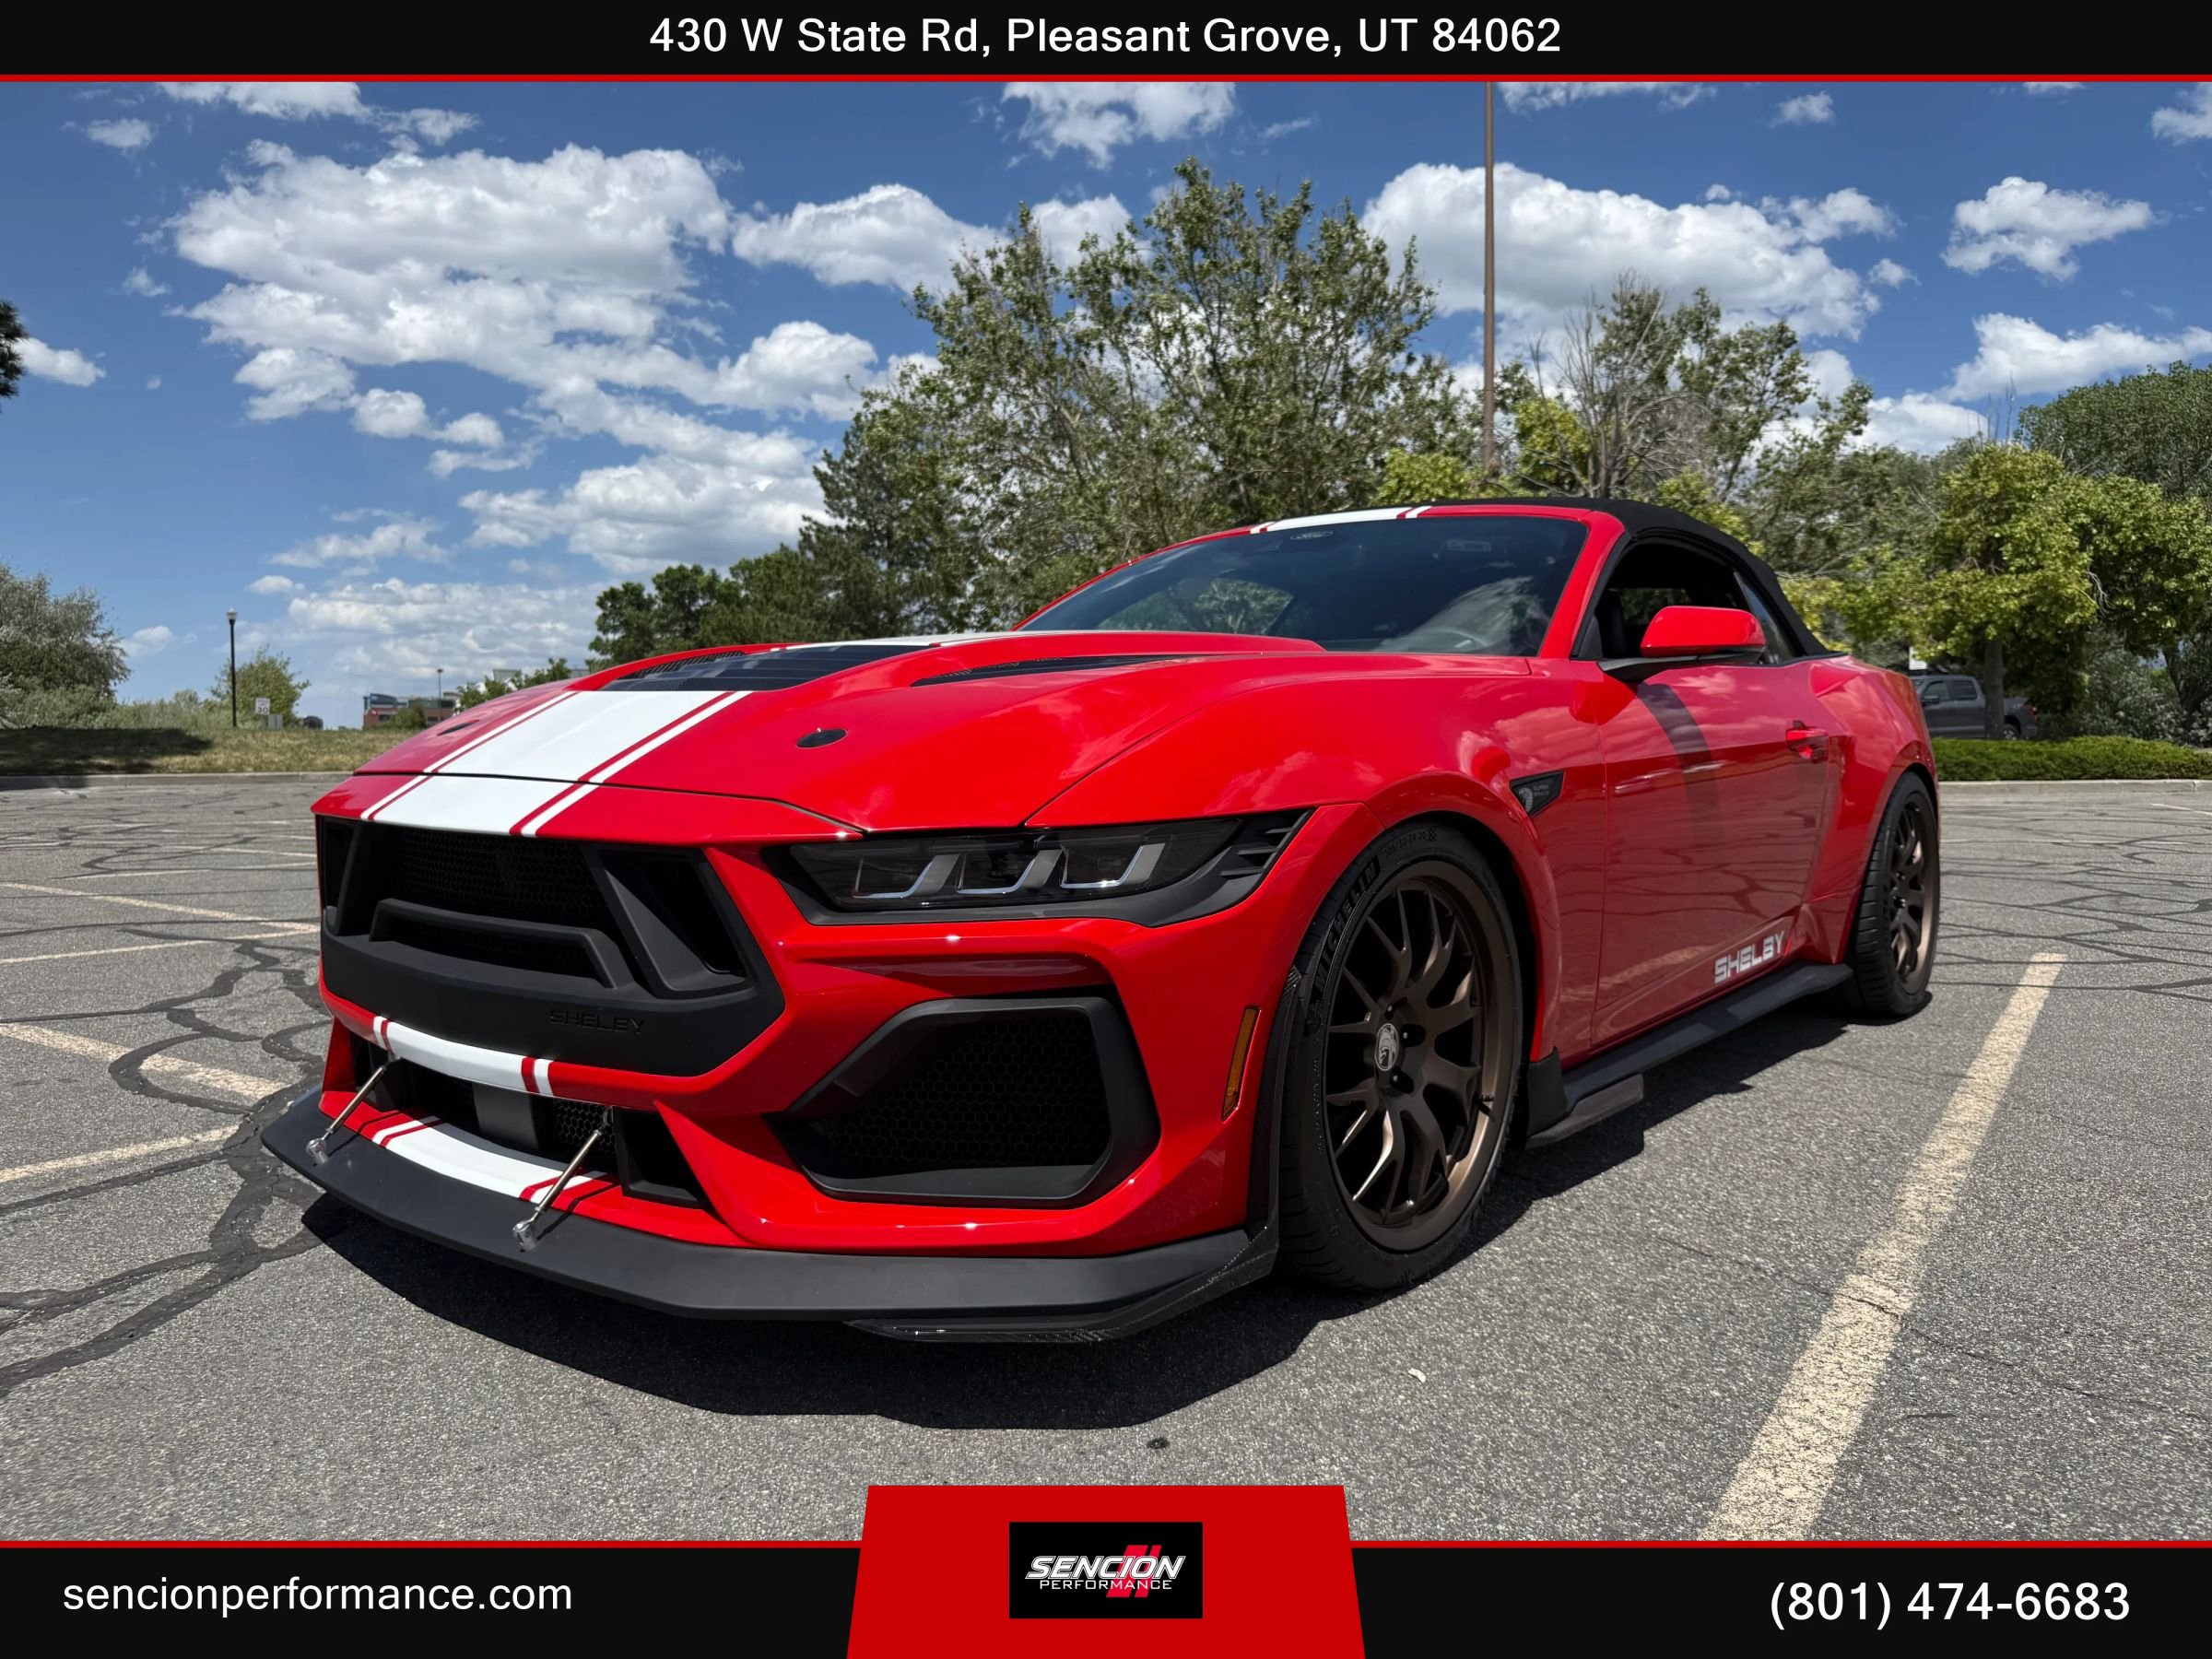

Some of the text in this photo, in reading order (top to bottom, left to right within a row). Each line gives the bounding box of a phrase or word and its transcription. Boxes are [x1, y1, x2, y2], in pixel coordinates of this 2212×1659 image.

[1314, 859, 1378, 993] MICHELIN
[1714, 931, 1784, 983] SHELBY
[549, 1009, 645, 1034] SHELBY
